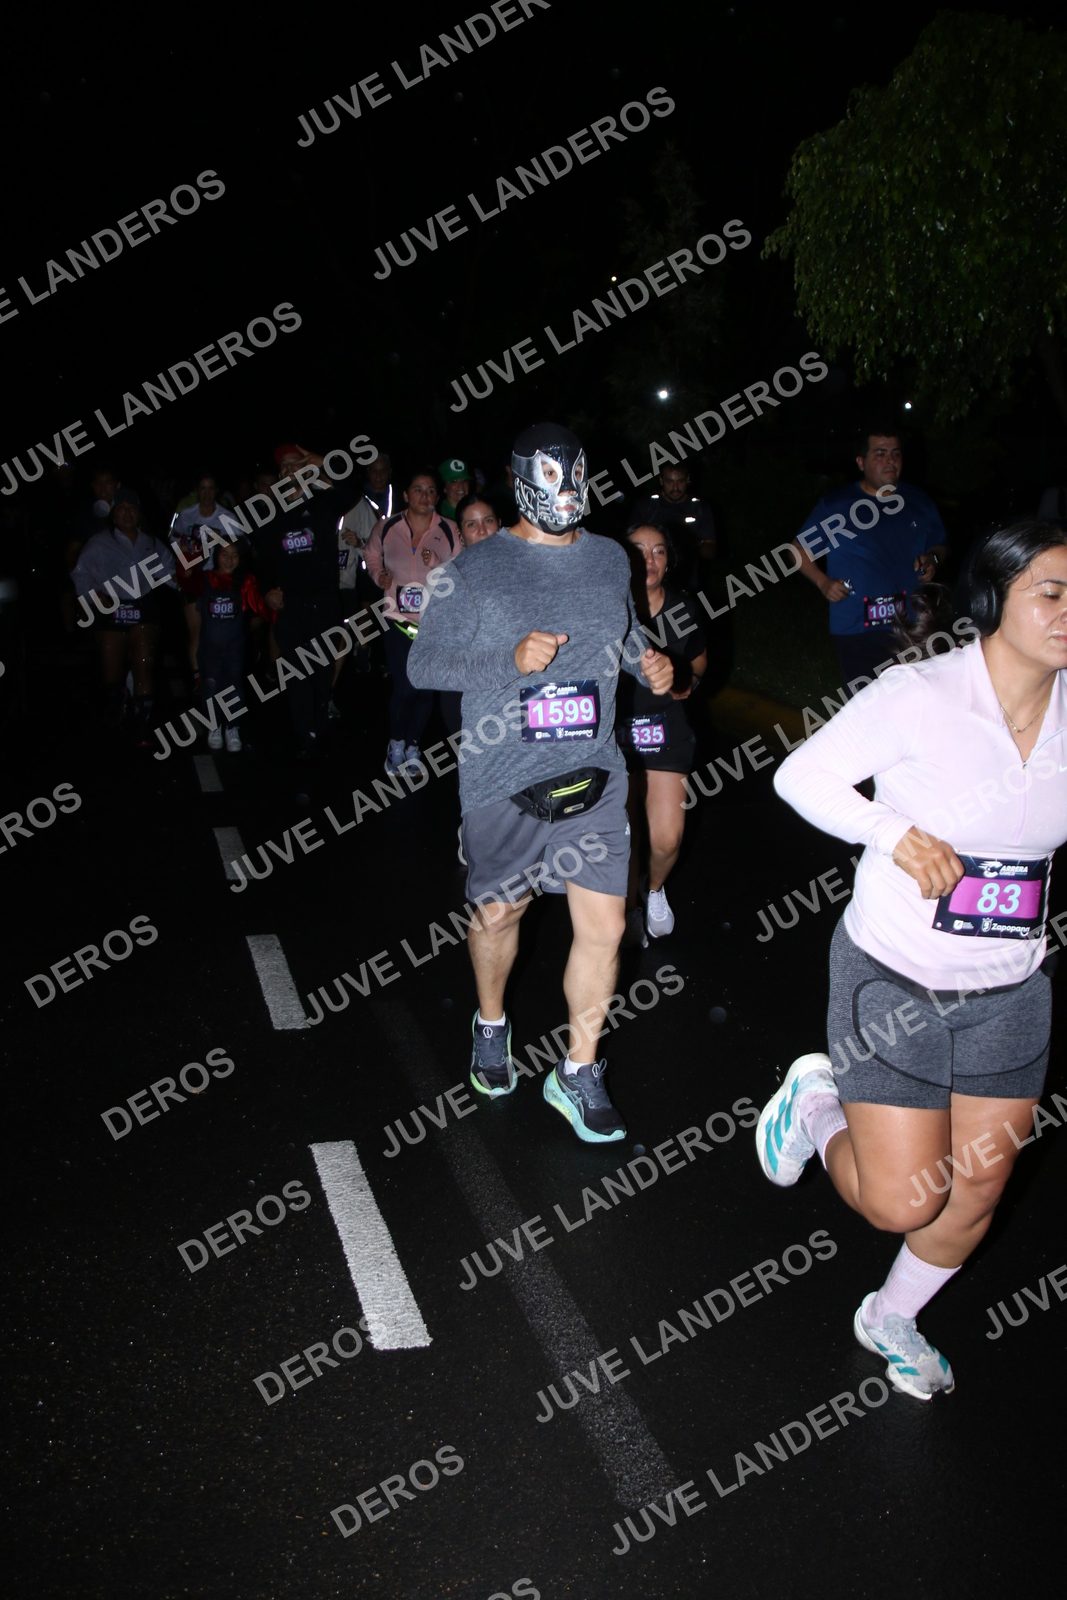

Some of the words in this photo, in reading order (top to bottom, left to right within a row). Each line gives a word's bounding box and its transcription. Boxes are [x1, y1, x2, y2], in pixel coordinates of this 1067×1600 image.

[287, 536, 308, 549] 909
[116, 610, 140, 619] 1838
[214, 602, 233, 614] 908
[870, 603, 896, 619] 109
[532, 698, 594, 726] 1599
[976, 882, 1022, 914] 83
